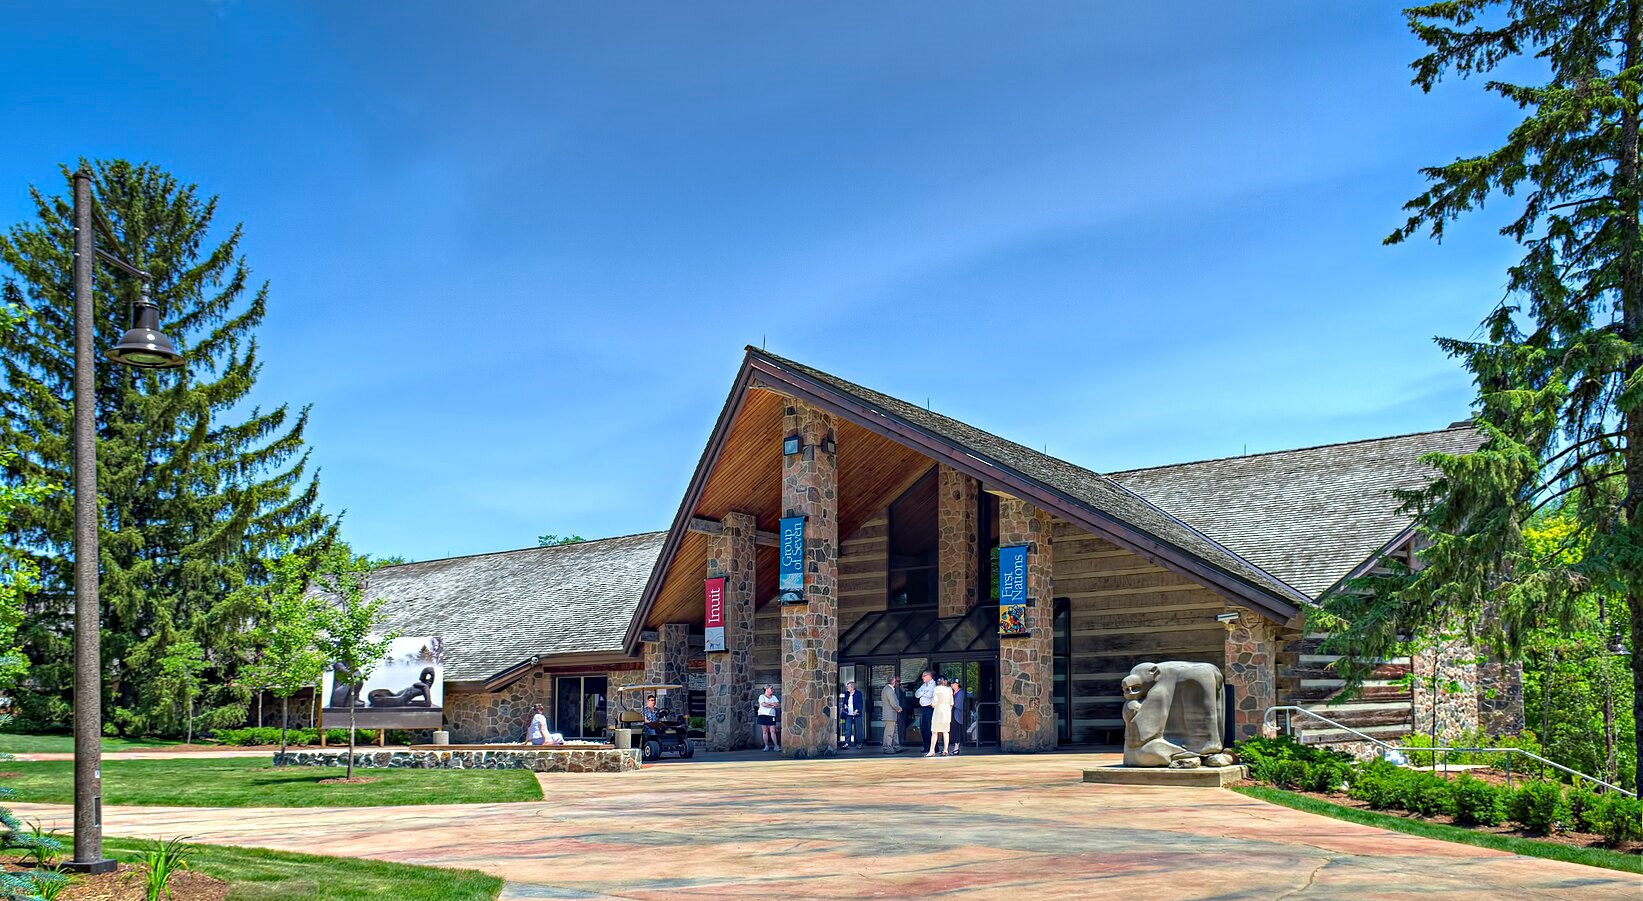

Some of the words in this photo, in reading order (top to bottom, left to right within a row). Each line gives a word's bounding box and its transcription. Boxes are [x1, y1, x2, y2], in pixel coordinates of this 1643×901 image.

[782, 529, 795, 566] Group
[792, 522, 802, 556] Seven
[791, 557, 802, 570] of
[1011, 554, 1024, 601] Nations
[1001, 571, 1013, 598] First
[708, 587, 721, 623] Inuit
